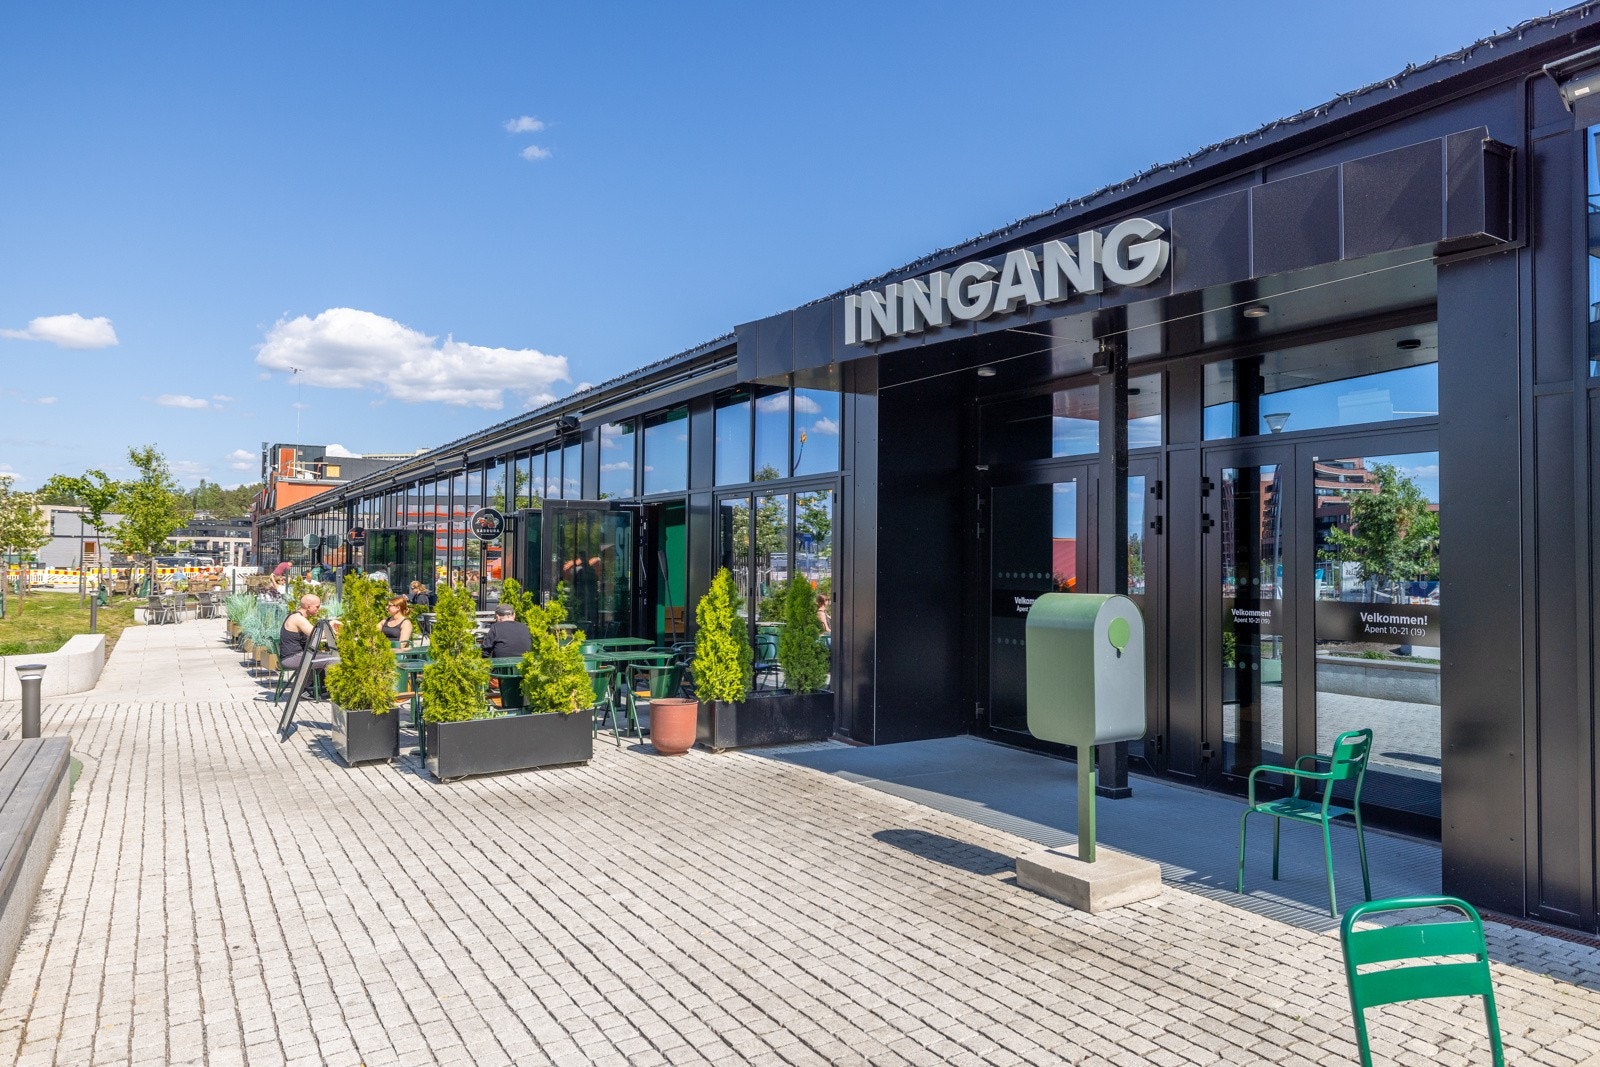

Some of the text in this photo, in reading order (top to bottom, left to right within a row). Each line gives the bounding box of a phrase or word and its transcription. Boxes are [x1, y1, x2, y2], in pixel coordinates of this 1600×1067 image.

[844, 217, 1170, 346] INNGANG
[1014, 597, 1035, 605] Velkom
[1231, 608, 1272, 617] Velkommen!
[1360, 612, 1428, 625] Velkommen!
[1364, 624, 1426, 637] Åpent 10-21 (19)
